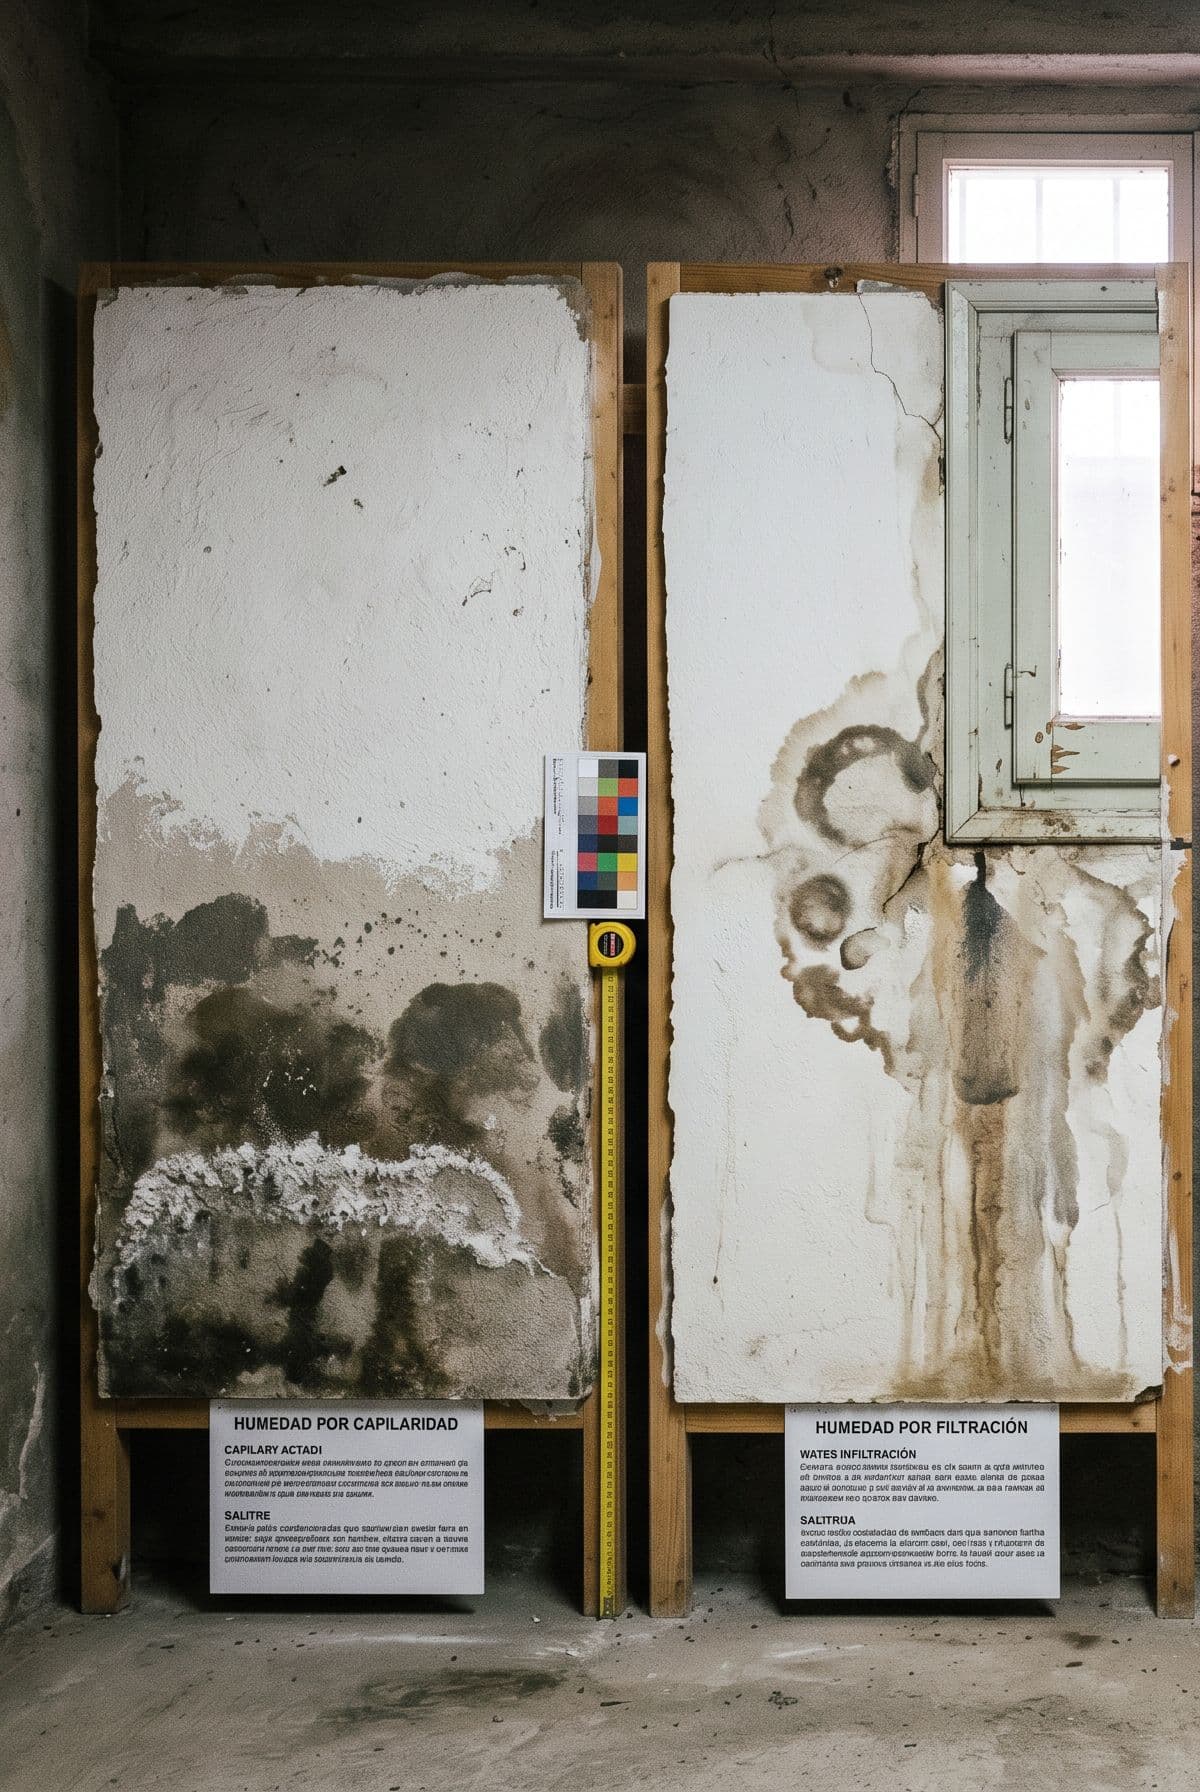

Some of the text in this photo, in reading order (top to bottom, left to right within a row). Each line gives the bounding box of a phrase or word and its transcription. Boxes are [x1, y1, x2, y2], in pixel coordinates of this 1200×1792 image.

[234, 1416, 459, 1431] HUMEDAD POR CAPILARIDAD
[816, 1417, 1028, 1434] HUMEDAD POR FILTRACIÓN
[224, 1445, 322, 1455] CAPILARY ACTADI
[800, 1447, 917, 1459] WATES INFILTRACIÓN
[224, 1511, 271, 1521] SALITRE
